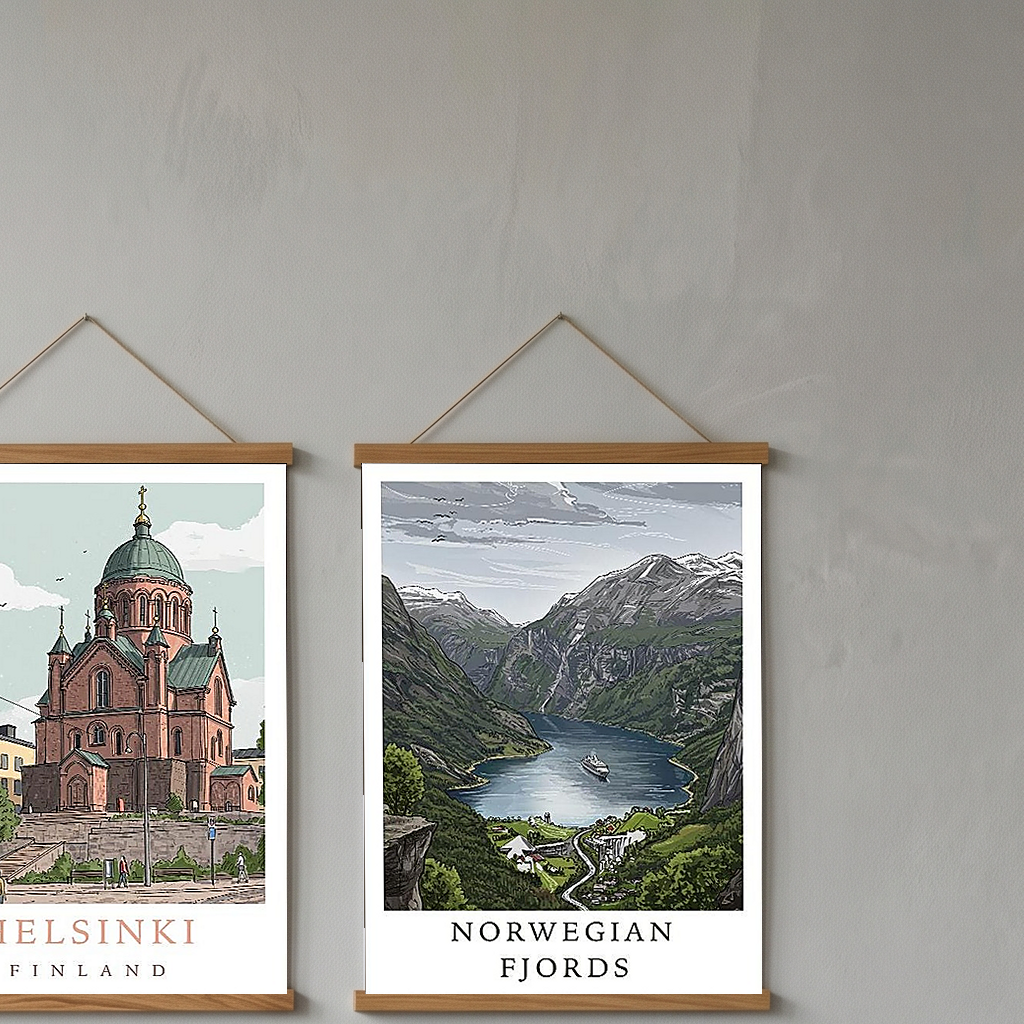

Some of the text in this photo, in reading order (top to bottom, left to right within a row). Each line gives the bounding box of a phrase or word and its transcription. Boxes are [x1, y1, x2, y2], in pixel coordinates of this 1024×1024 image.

[450, 920, 673, 943] NORWEGIAN
[9, 964, 169, 977] FINLAND
[500, 957, 629, 983] FJORDS
